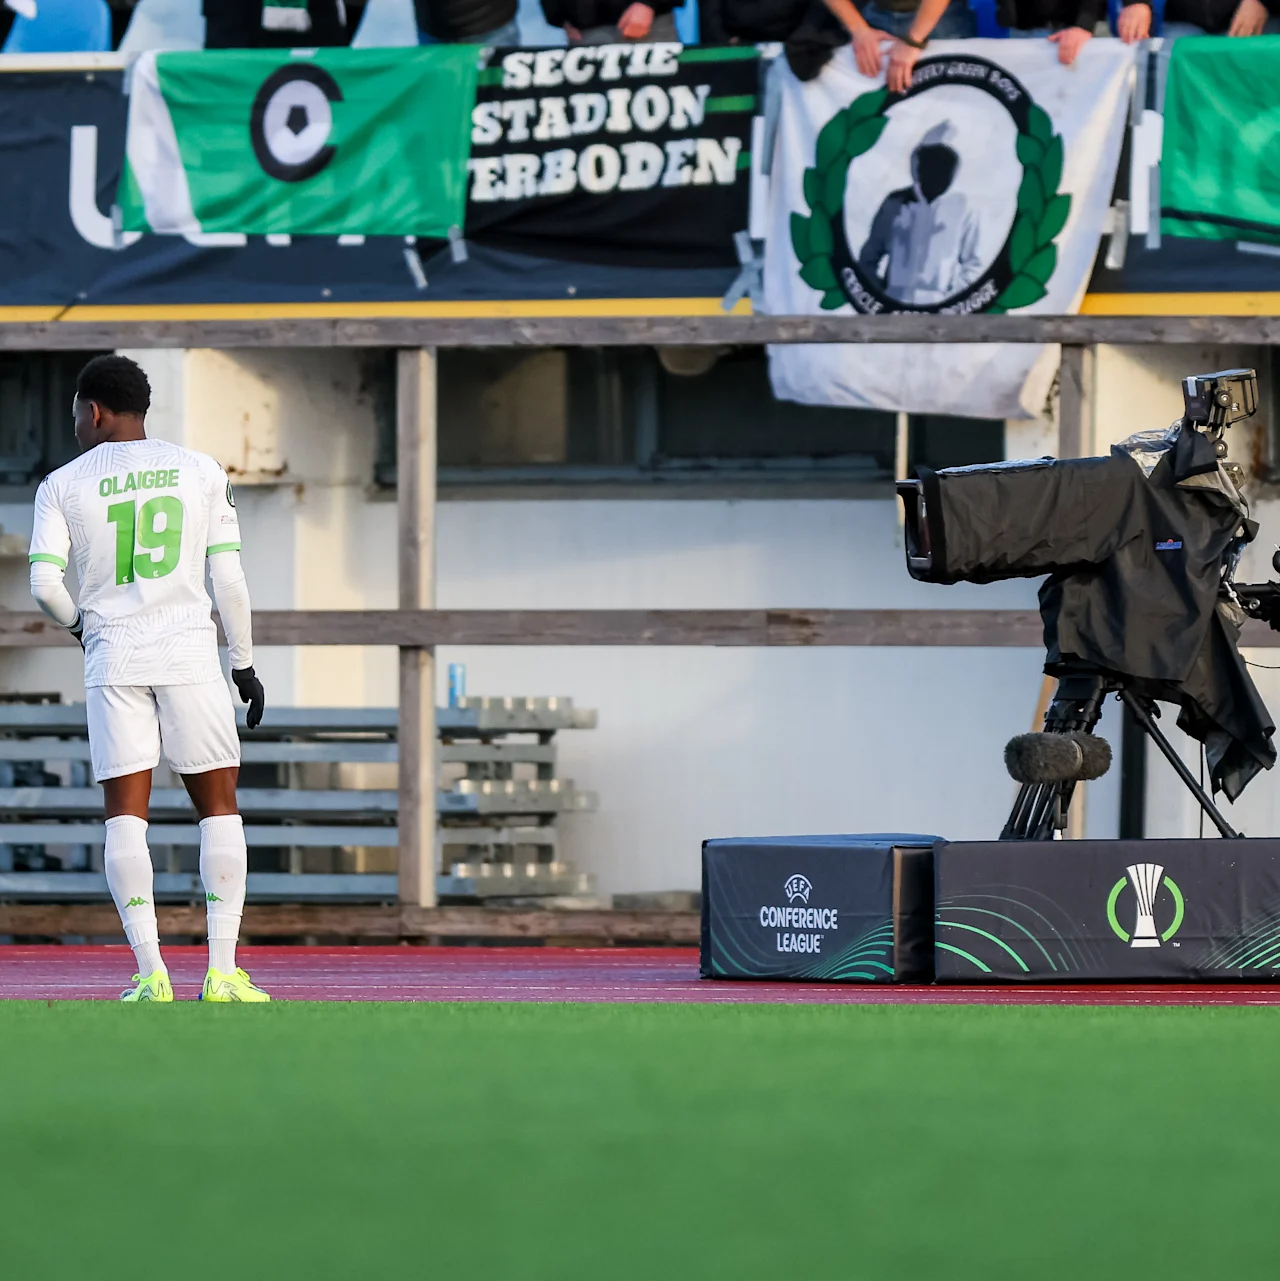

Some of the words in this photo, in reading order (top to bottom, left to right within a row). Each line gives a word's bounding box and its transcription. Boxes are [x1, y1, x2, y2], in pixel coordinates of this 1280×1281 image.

[502, 42, 683, 89] SECTIE
[471, 84, 710, 145] STADION
[468, 136, 742, 202] ERBODEN
[99, 469, 179, 497] OLAIGBE
[107, 495, 183, 586] 19
[785, 879, 810, 900] UEFA
[760, 906, 838, 929] CONFERENCE
